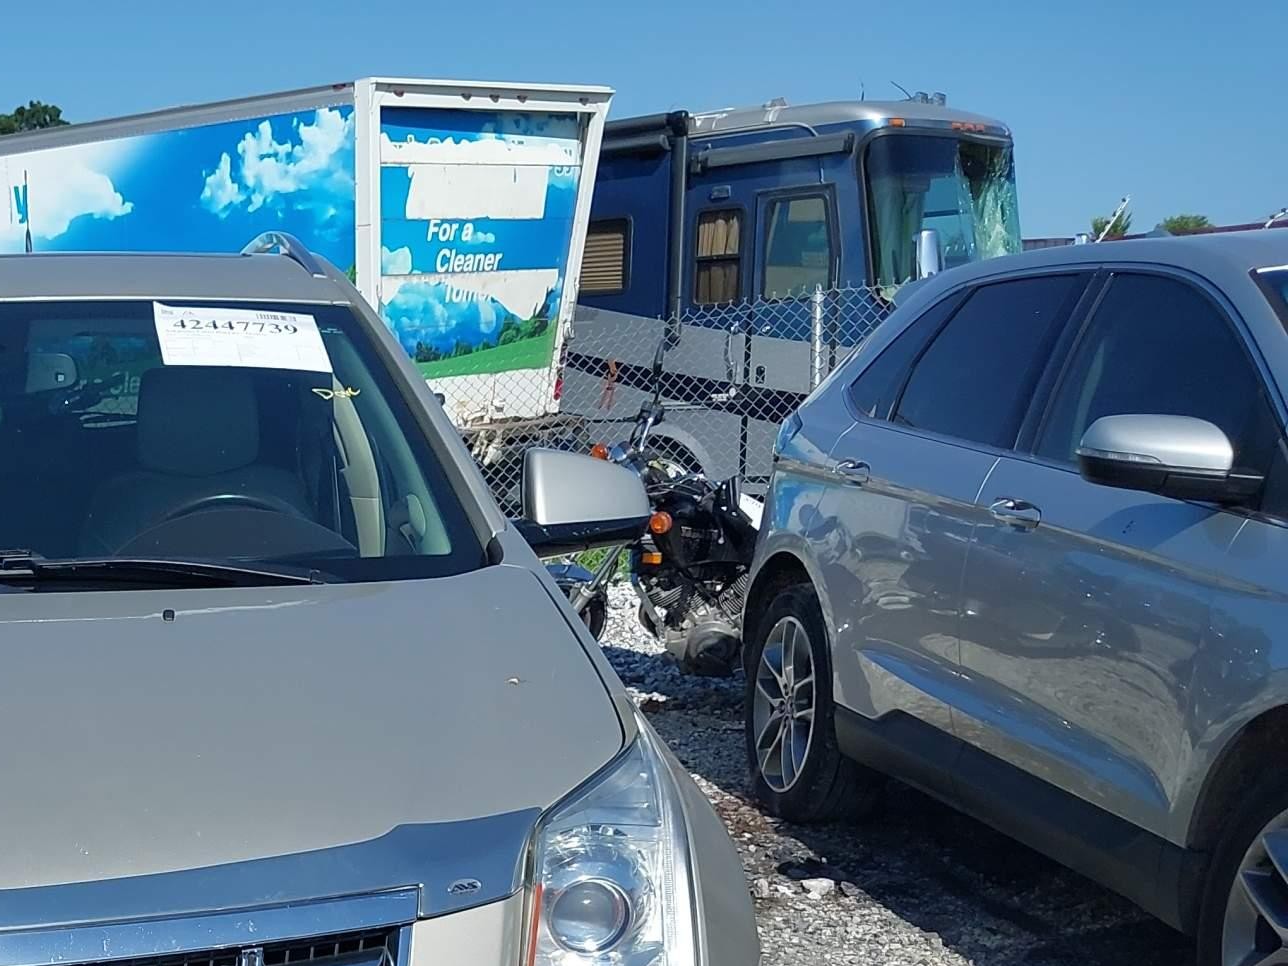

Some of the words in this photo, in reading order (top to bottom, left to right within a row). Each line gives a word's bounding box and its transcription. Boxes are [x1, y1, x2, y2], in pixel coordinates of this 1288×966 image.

[427, 219, 459, 243] For
[461, 221, 475, 242] a
[435, 248, 503, 273] Cleaner
[173, 318, 298, 335] 42447739
